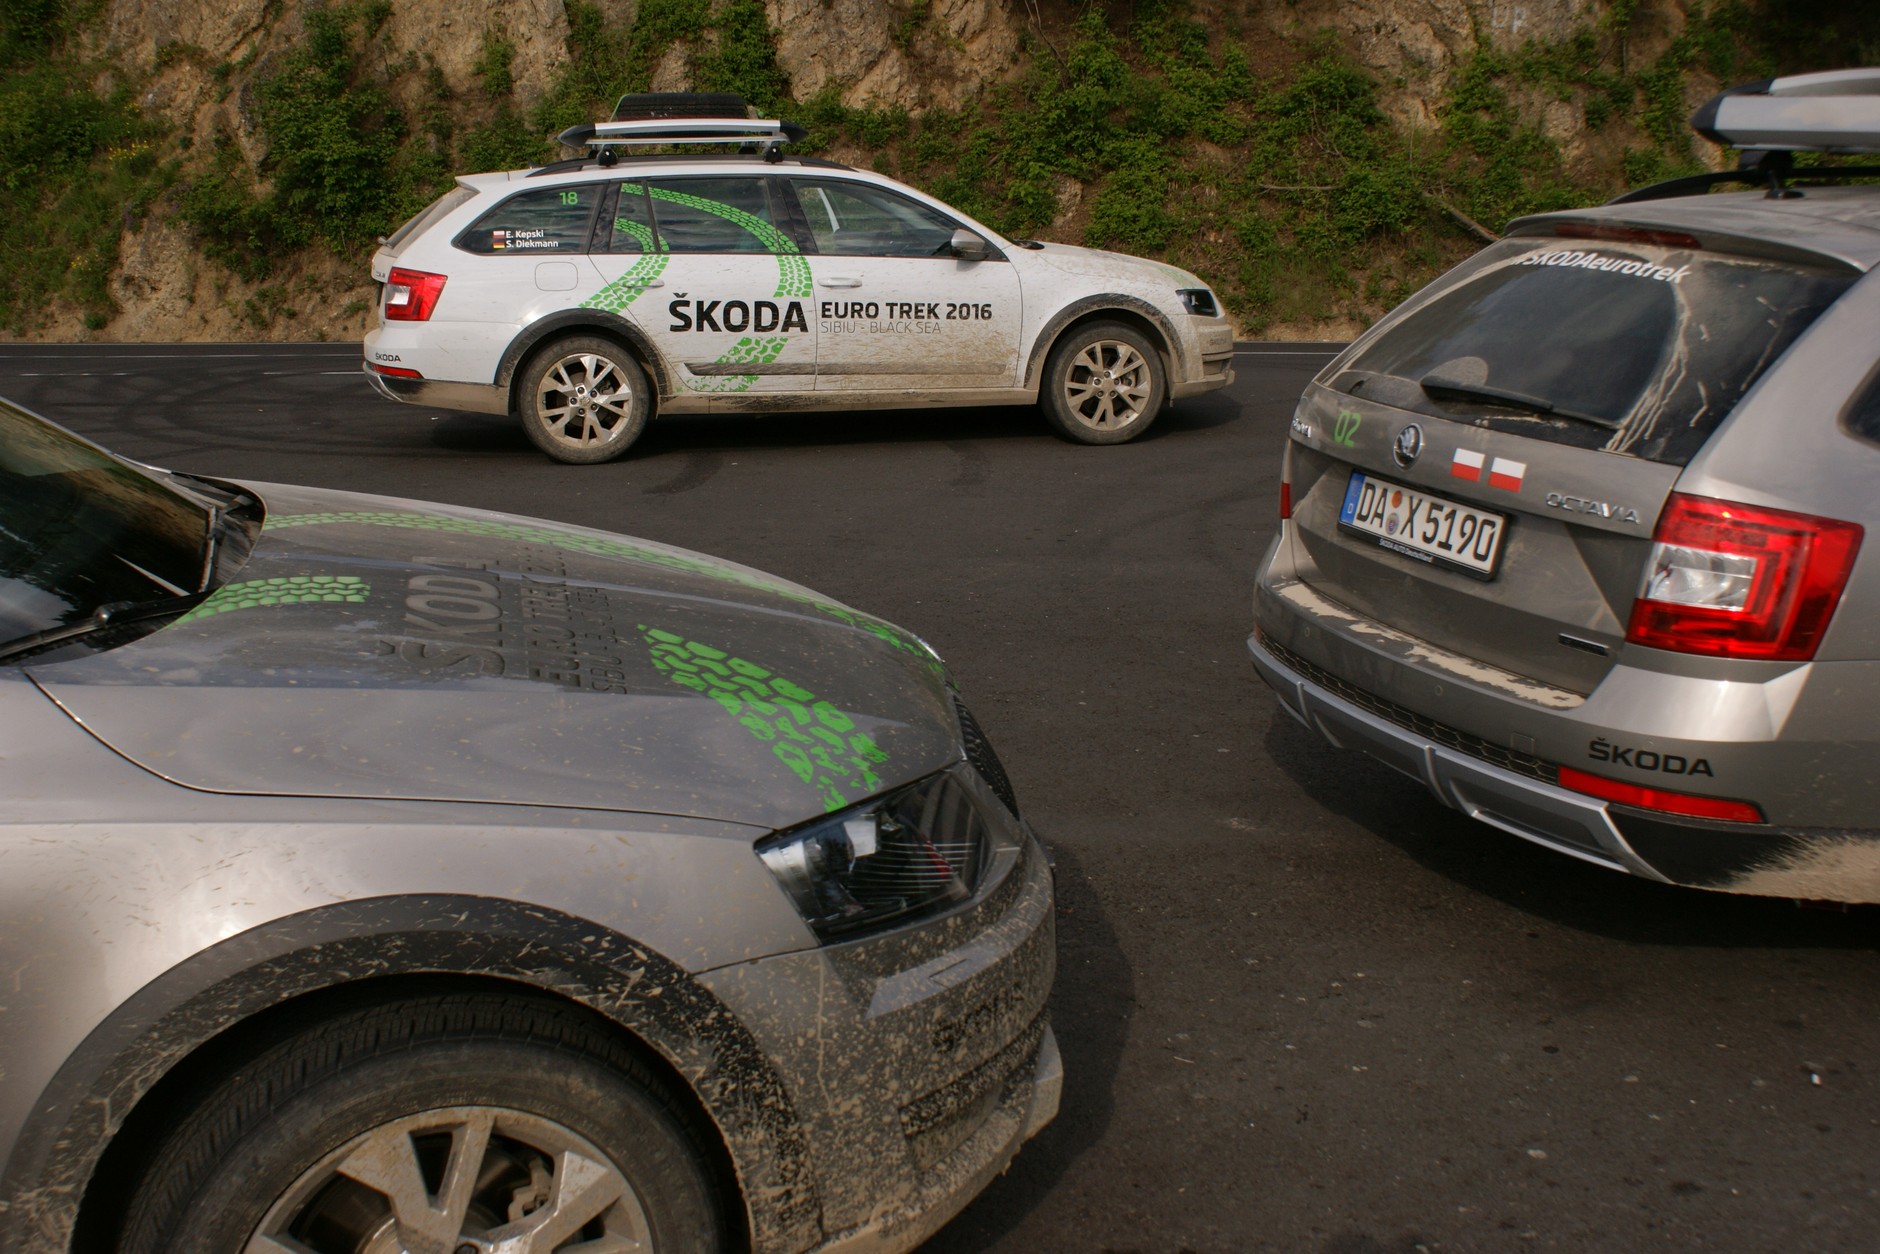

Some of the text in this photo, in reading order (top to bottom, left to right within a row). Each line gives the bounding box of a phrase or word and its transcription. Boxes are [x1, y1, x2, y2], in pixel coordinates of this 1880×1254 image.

[559, 191, 579, 206] 18
[505, 229, 545, 241] E. Kepski
[505, 239, 559, 249] S. Diekmann
[669, 292, 809, 333] ŠKODA
[821, 301, 993, 321] EURO TREK 2016
[820, 321, 856, 335] SIBIU
[869, 321, 912, 335] BLACK
[915, 321, 943, 335] SEA
[1334, 409, 1362, 448] 02
[1347, 503, 1354, 514] D
[1545, 491, 1641, 526] OCTAVIA
[1356, 482, 1496, 563] DA X 5190
[378, 556, 505, 677] ŠKODA
[1588, 736, 1714, 778] ŠKODA
